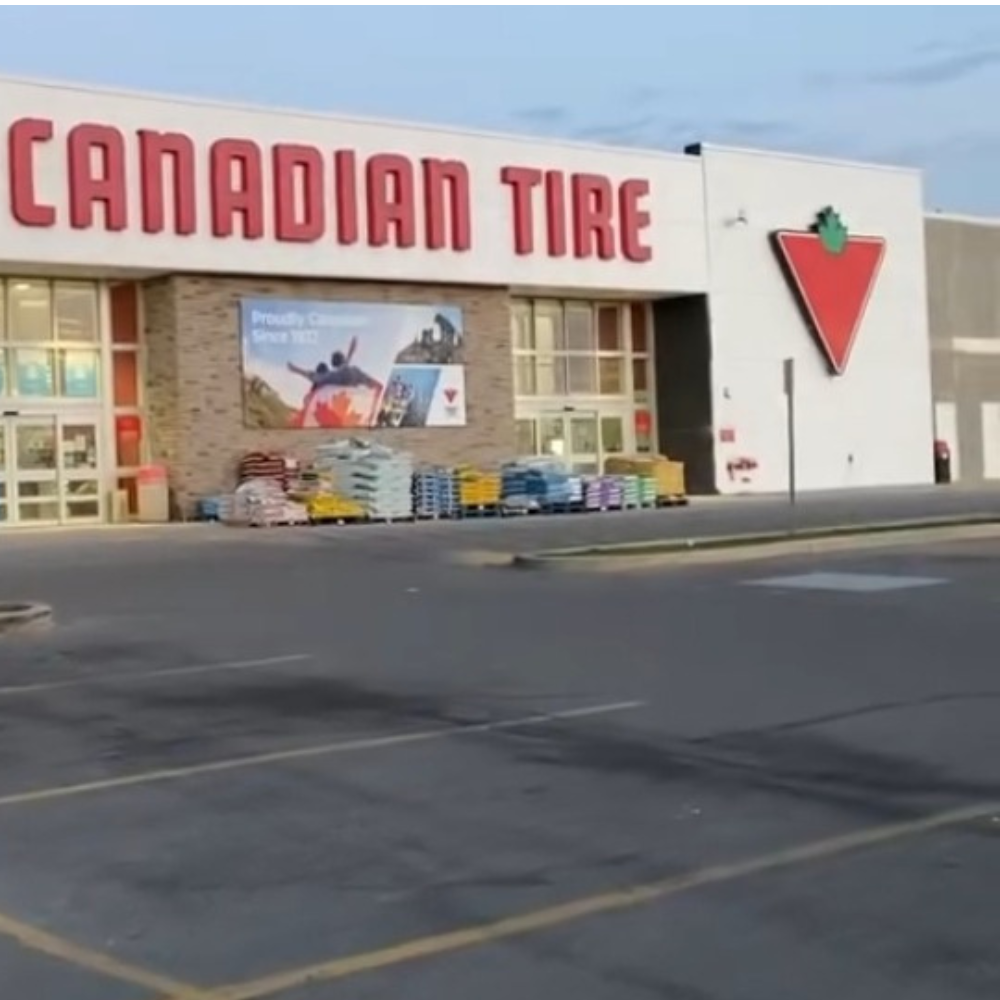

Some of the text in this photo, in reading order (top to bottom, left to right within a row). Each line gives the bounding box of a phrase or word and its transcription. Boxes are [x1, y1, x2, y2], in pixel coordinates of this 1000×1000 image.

[8, 117, 654, 263] CANADIAN TIRE
[251, 309, 305, 328] Proudly
